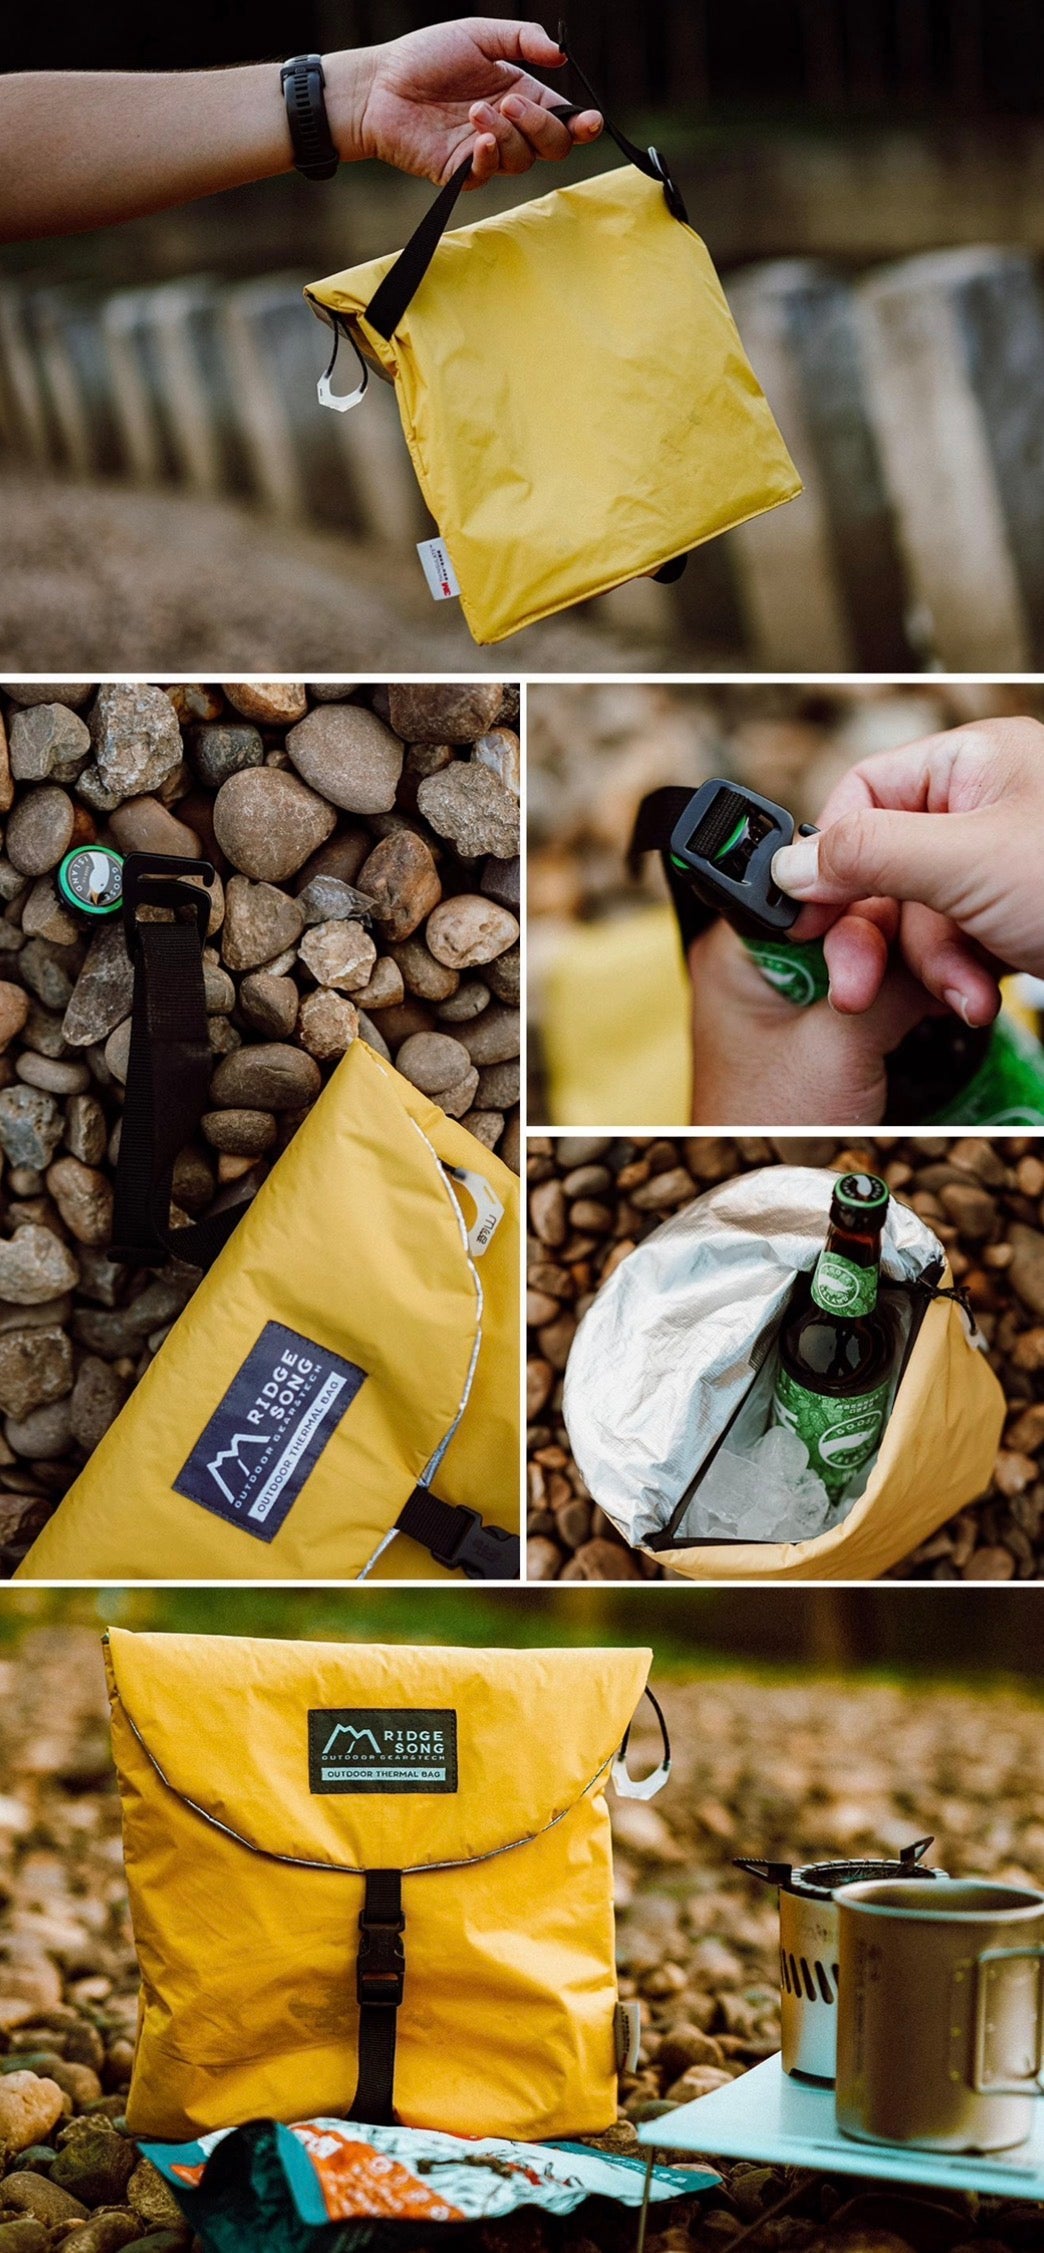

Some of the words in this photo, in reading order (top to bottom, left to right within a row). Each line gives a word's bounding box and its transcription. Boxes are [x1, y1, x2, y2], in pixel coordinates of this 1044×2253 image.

[441, 582, 451, 596] 3M
[72, 856, 89, 892] ISLAND
[246, 1349, 298, 1425] RIDGE
[269, 1357, 313, 1420] SONG
[257, 1459, 293, 1513] OUTDOOR
[290, 1406, 324, 1458] THERMAL
[322, 1381, 339, 1405] BAG
[234, 1446, 275, 1509] OUTDOOR
[384, 1730, 444, 1741] RIDGE
[394, 1743, 445, 1754] SONG
[327, 1770, 373, 1778] OUTDOOR
[376, 1770, 419, 1778] THERMAL
[421, 1770, 441, 1778] BAG
